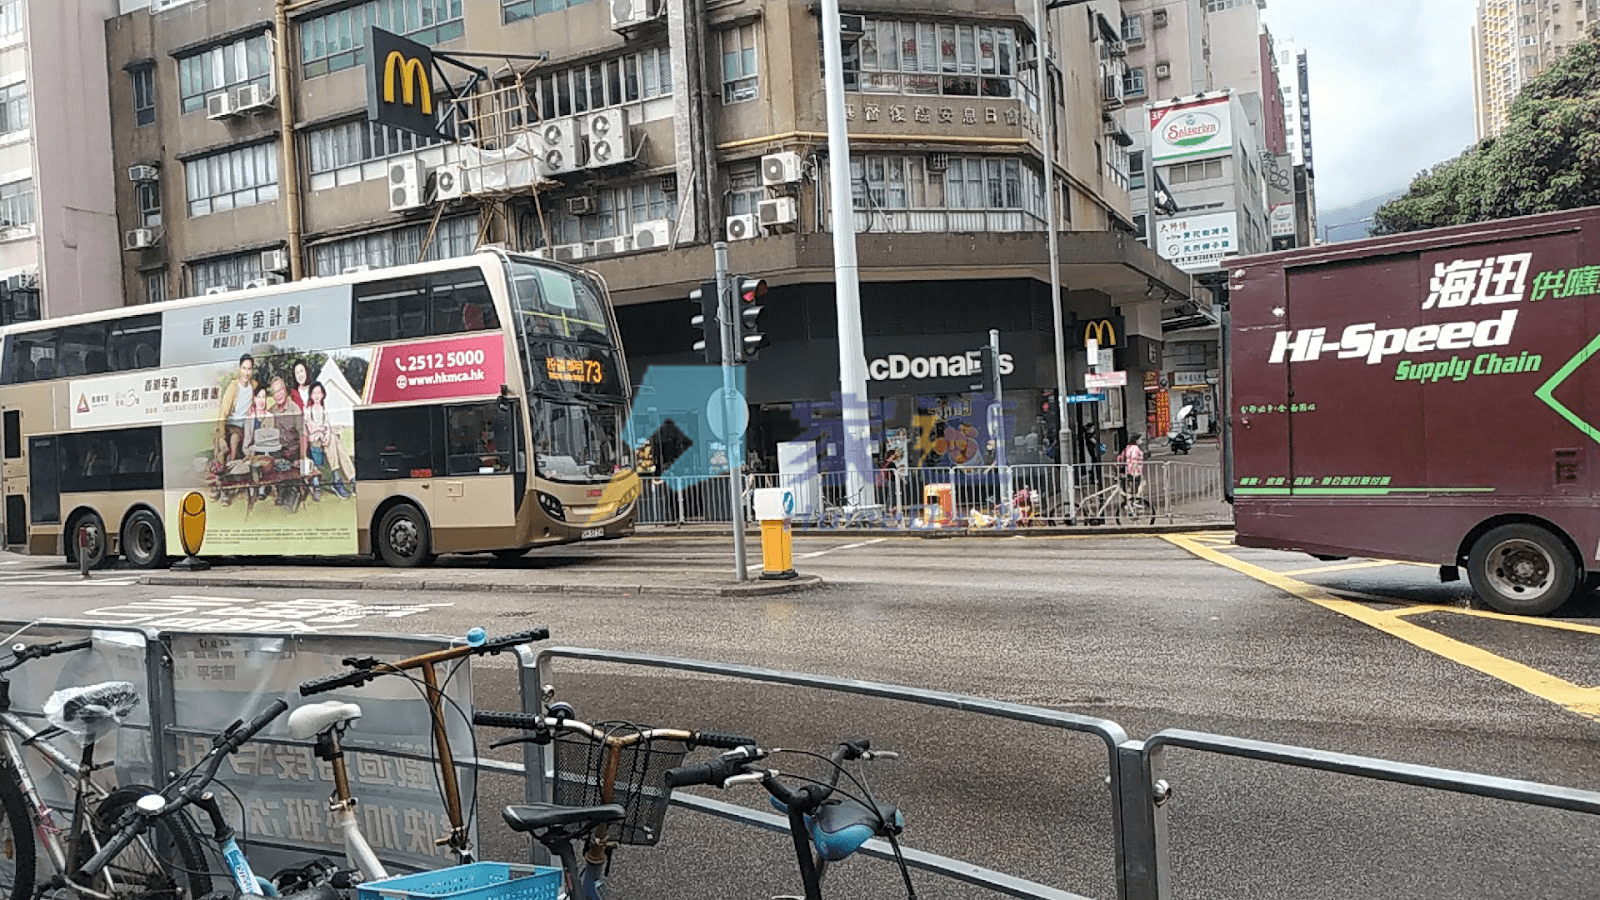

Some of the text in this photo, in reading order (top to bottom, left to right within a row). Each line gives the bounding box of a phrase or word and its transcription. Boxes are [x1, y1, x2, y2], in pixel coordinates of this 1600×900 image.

[1151, 110, 1164, 121] 3F
[1422, 252, 1600, 310] 海迅 供應
[203, 304, 300, 336] 香港年金計劃
[1268, 309, 1519, 364] Hi-Speed
[408, 349, 485, 371] 2512 5000
[584, 360, 603, 384] 73
[864, 351, 1014, 381] cDonals
[1395, 351, 1543, 384] Supply Chain
[145, 377, 178, 391] 香港年金
[408, 369, 485, 386] www.hkmca.hk
[163, 388, 219, 404] 保費折扣優惠
